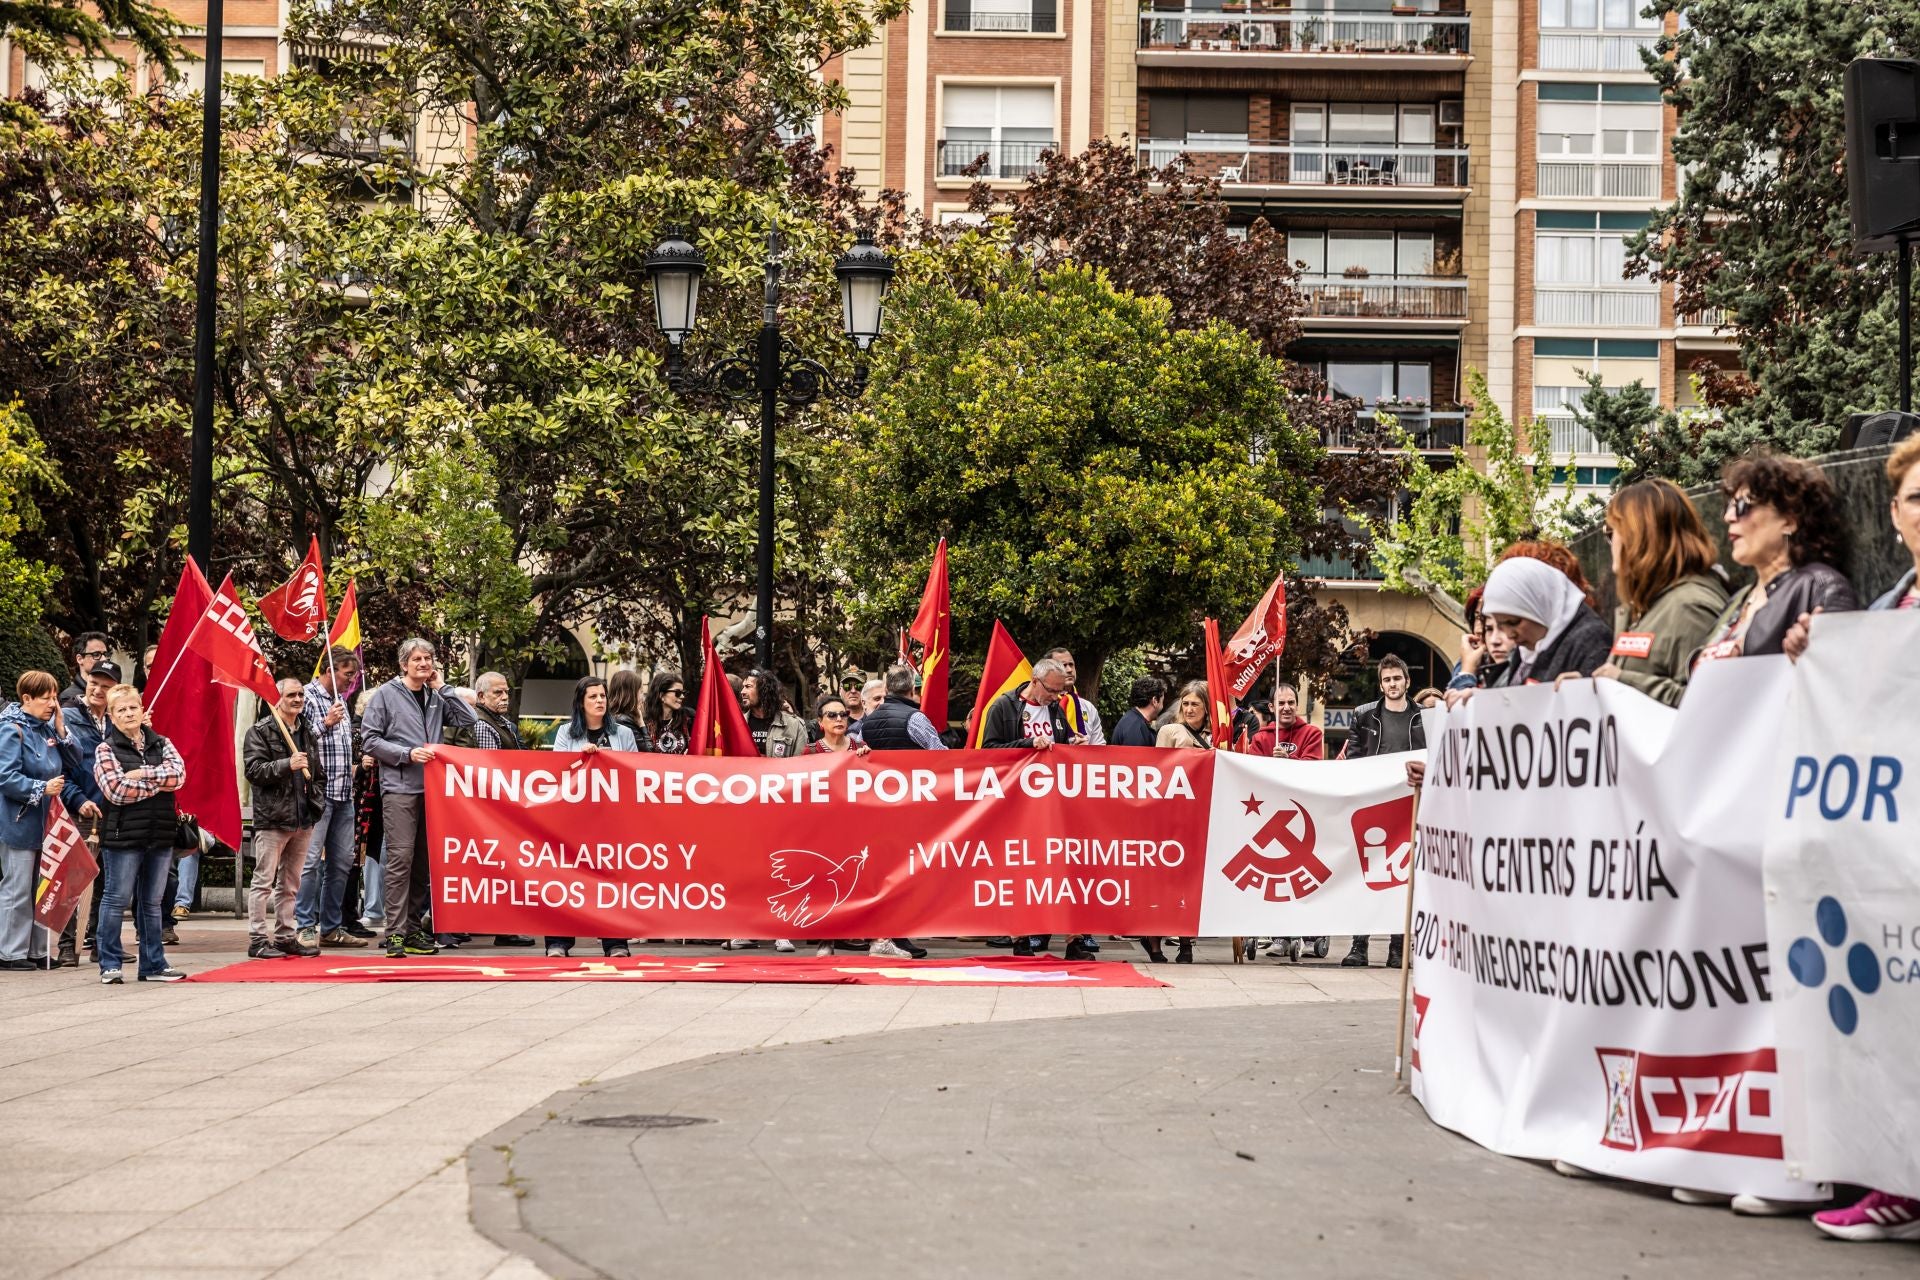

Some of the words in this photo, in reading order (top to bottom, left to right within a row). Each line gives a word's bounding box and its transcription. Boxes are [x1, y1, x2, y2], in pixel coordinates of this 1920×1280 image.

[444, 759, 619, 804] NINGÚN
[635, 769, 830, 805] RECORTE
[847, 769, 938, 803] POR
[953, 766, 1005, 801] LA
[1019, 762, 1196, 800] GUERRA
[1785, 753, 1904, 823] POR
[443, 837, 506, 870] PAZ,
[518, 840, 669, 871] SALARIOS
[678, 844, 698, 870] Y
[909, 840, 994, 875] ¡VIVA
[1005, 839, 1037, 866] EL
[1046, 838, 1185, 867] PRIMERO
[1588, 839, 1618, 900] DE
[1623, 820, 1680, 901] DÍA
[443, 876, 585, 908] EMPLEOS
[596, 882, 726, 910] DIGNOS
[974, 879, 1014, 907] DE
[1026, 877, 1131, 906] MAYO!
[1235, 868, 1319, 902] PCE
[1558, 942, 1773, 1010] ONDICIONE
